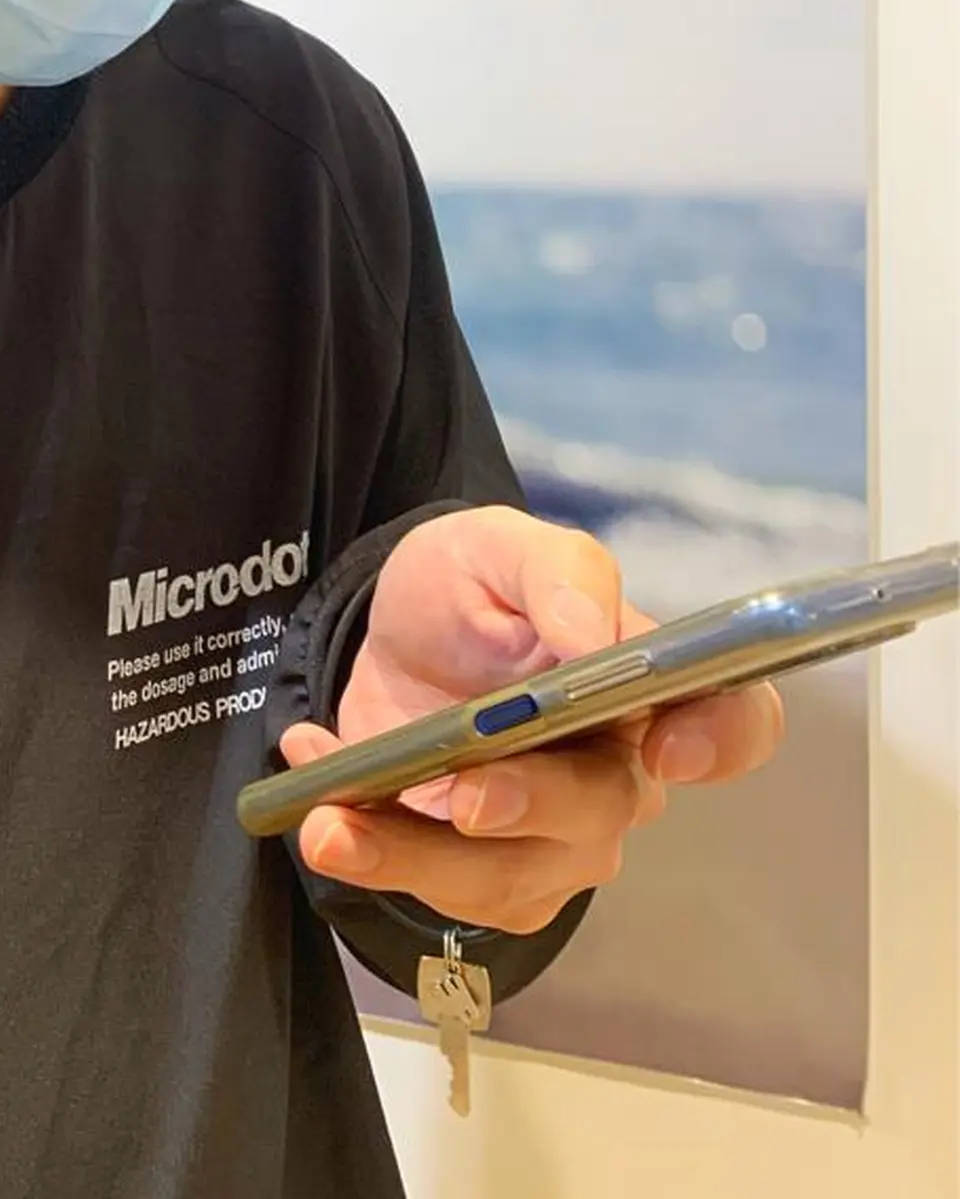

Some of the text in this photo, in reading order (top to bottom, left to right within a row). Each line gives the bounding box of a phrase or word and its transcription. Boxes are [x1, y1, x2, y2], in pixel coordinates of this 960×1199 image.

[107, 652, 160, 682] Please
[164, 641, 191, 664] use
[193, 635, 205, 655] it
[111, 689, 138, 712] the
[141, 671, 195, 701] dosage
[198, 658, 232, 684] and
[114, 701, 211, 750] HAZARDOUS
